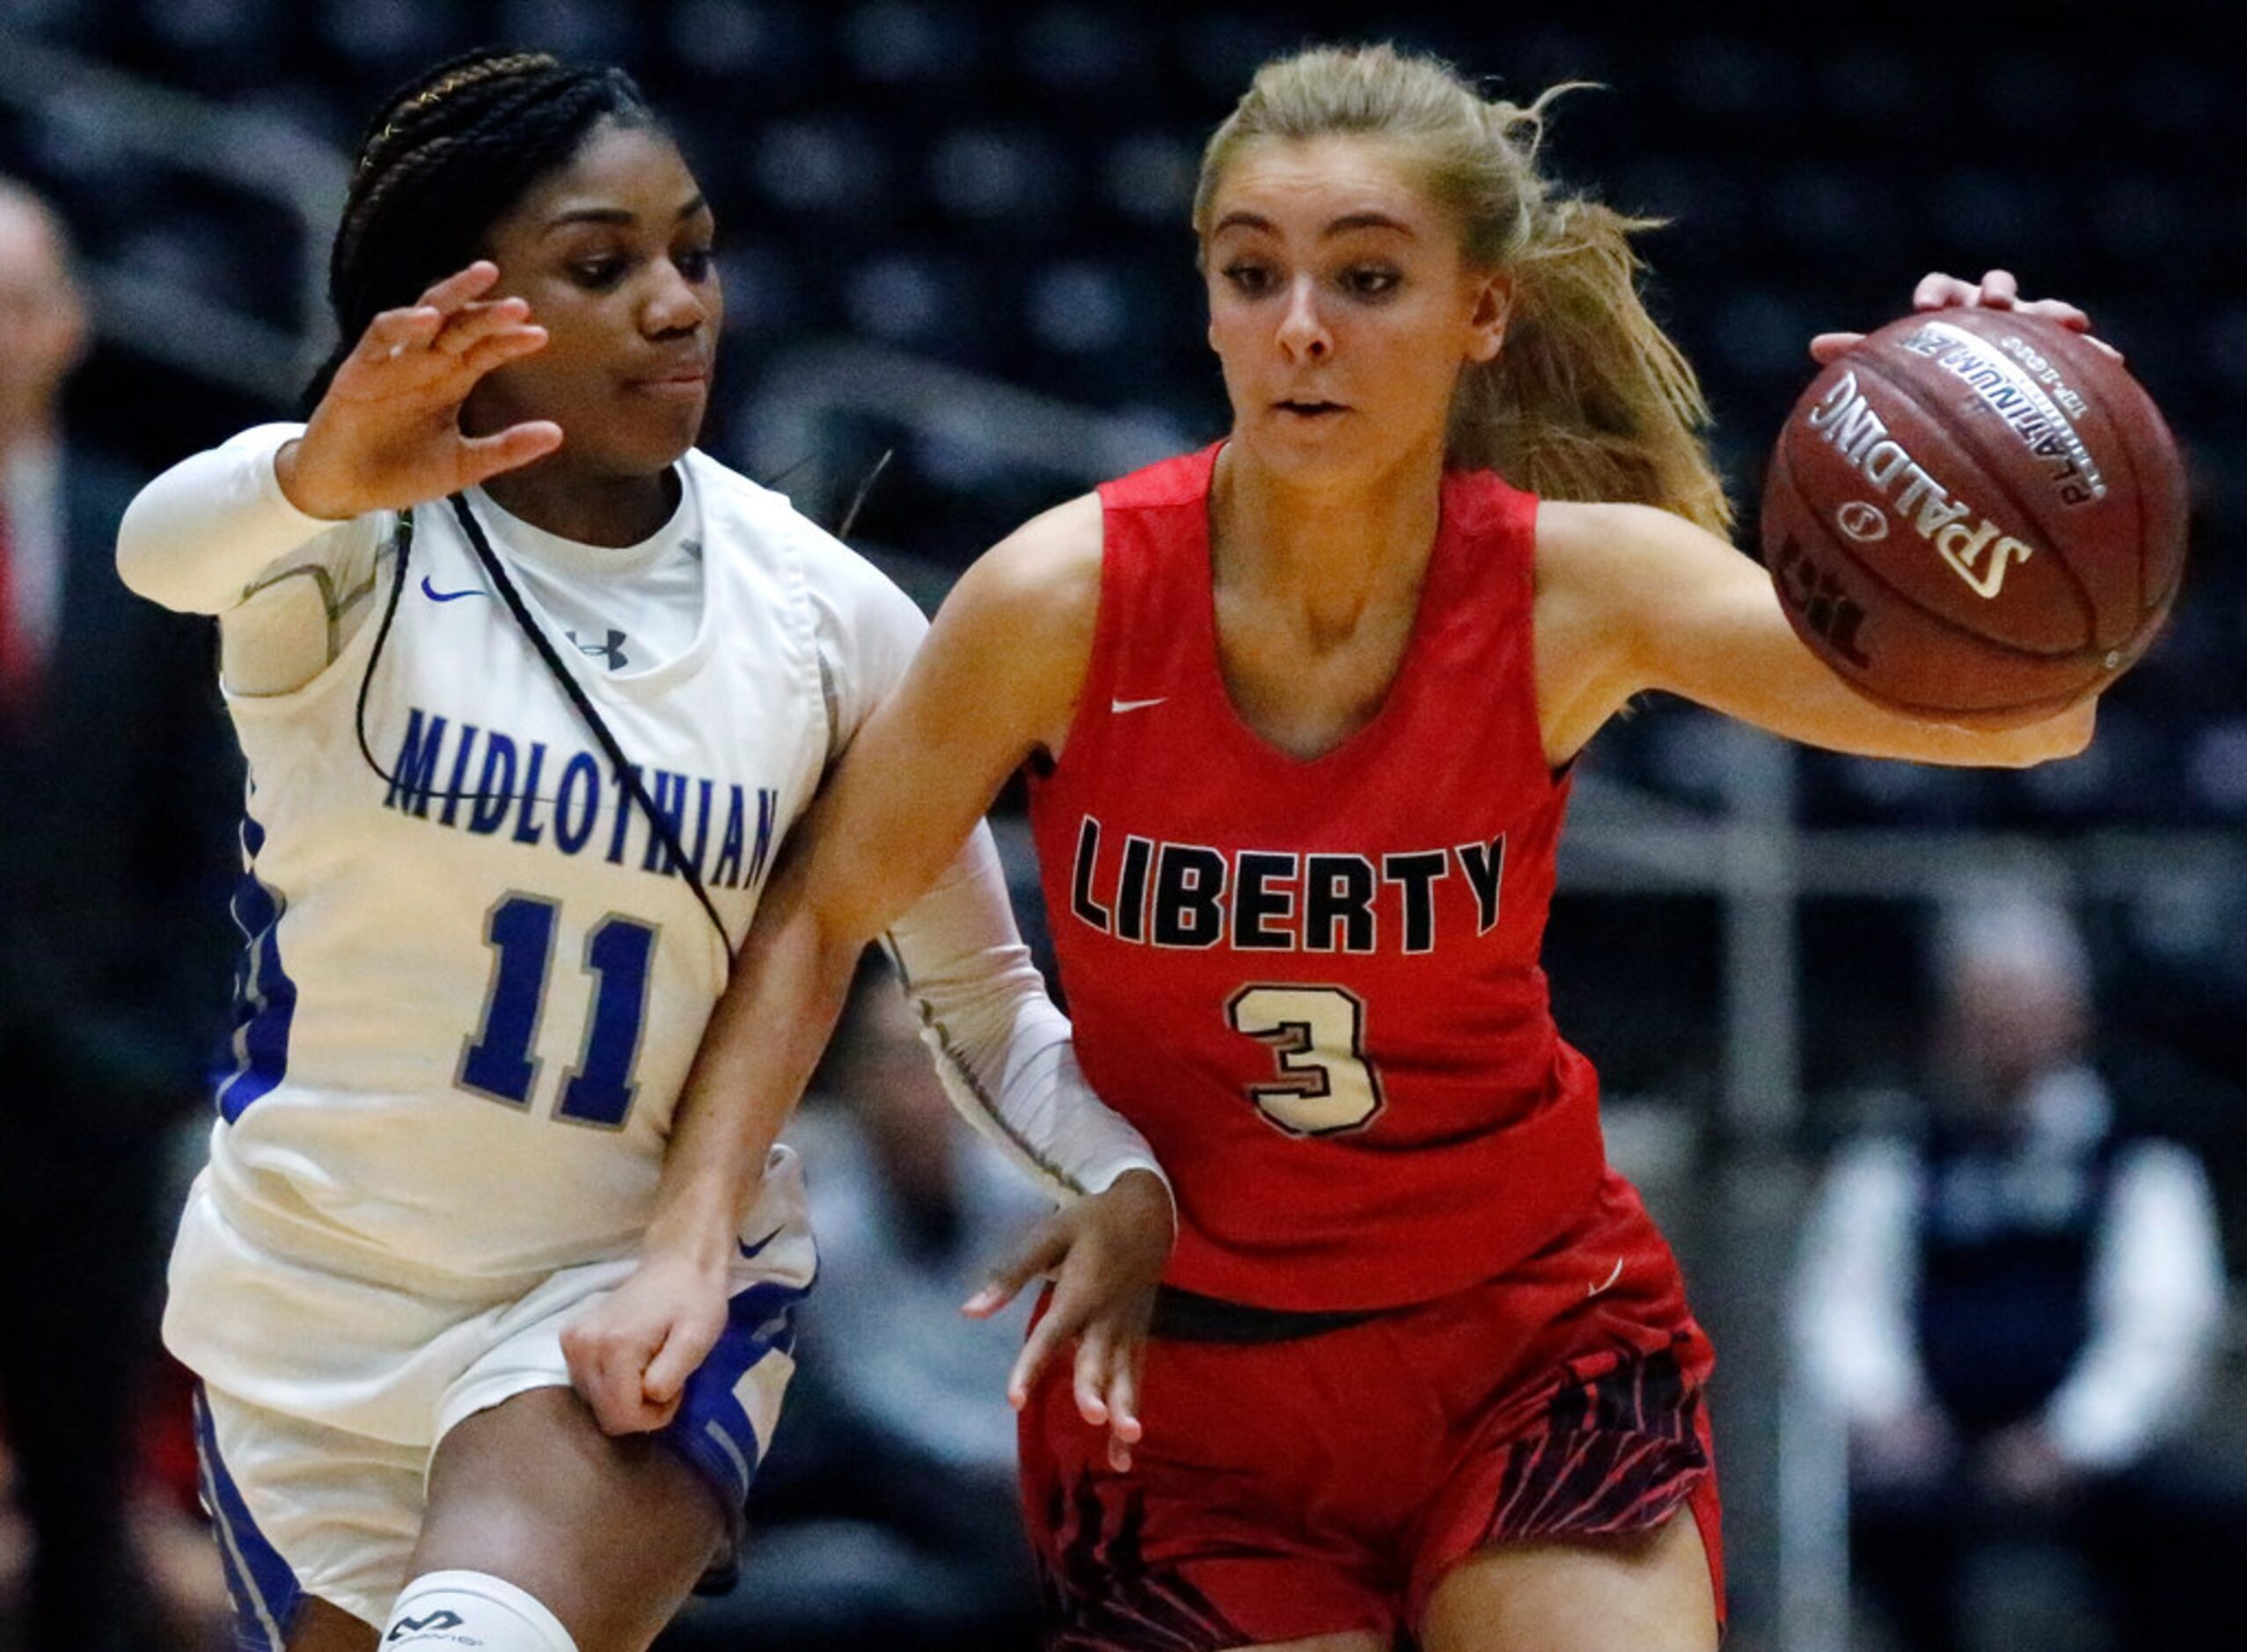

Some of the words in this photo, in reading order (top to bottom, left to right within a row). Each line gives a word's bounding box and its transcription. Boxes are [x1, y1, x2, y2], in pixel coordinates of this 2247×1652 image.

[1809, 371, 2032, 599] SPALDING
[1940, 347, 2093, 508] PLATINUM
[384, 707, 779, 891] MIDLOTHIAN
[1071, 814, 1506, 955] LIBERTY
[451, 888, 663, 1133] 11
[1224, 982, 1387, 1139] 3
